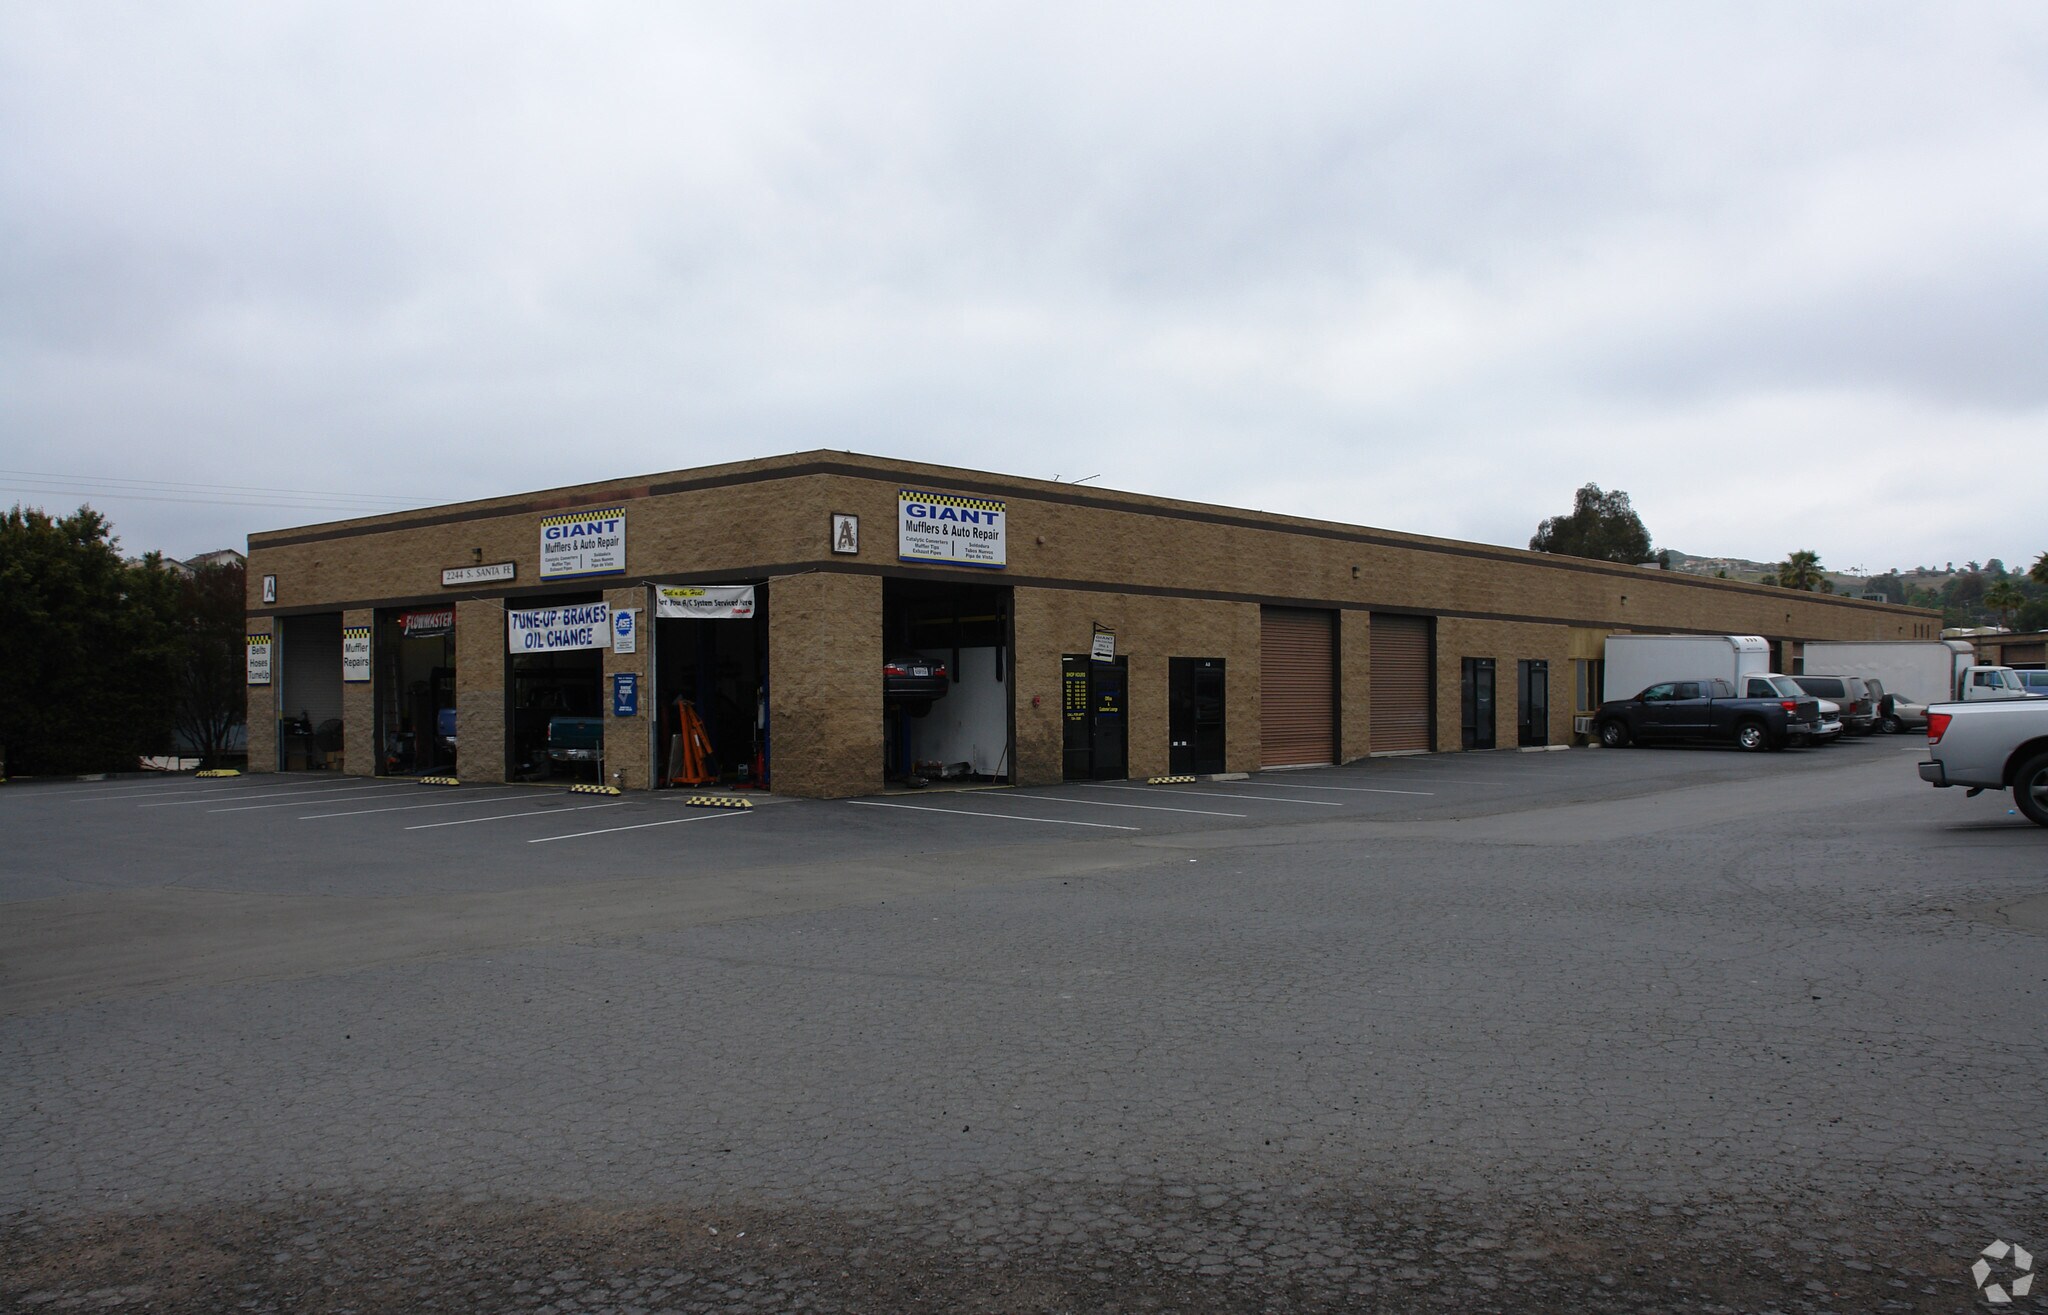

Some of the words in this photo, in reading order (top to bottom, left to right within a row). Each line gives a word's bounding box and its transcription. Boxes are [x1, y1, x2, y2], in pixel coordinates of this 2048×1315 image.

[906, 503, 999, 525] GIANT
[545, 519, 619, 540] GIANT
[837, 520, 854, 549] A
[905, 519, 940, 535] Mufflers
[942, 523, 948, 536] &
[951, 525, 971, 538] Auto
[972, 527, 1000, 541] Repair
[544, 541, 571, 554] Mufflers
[573, 540, 578, 551] &
[580, 539, 596, 550] Auto
[597, 535, 620, 549] Repair
[446, 570, 463, 580] 2244
[466, 569, 473, 578] S.
[476, 566, 500, 577] SANTA
[503, 565, 512, 574] FE
[266, 578, 274, 598] A
[404, 611, 453, 635] FLOWMASTER
[511, 610, 557, 630] TUNE-UP
[563, 605, 607, 626] BRAKES
[344, 642, 369, 652] Muffler
[524, 631, 544, 648] OIL
[546, 627, 593, 648] CHANGE
[251, 645, 266, 655] Belts
[249, 659, 268, 668] Hoses
[344, 657, 369, 669] Repairs
